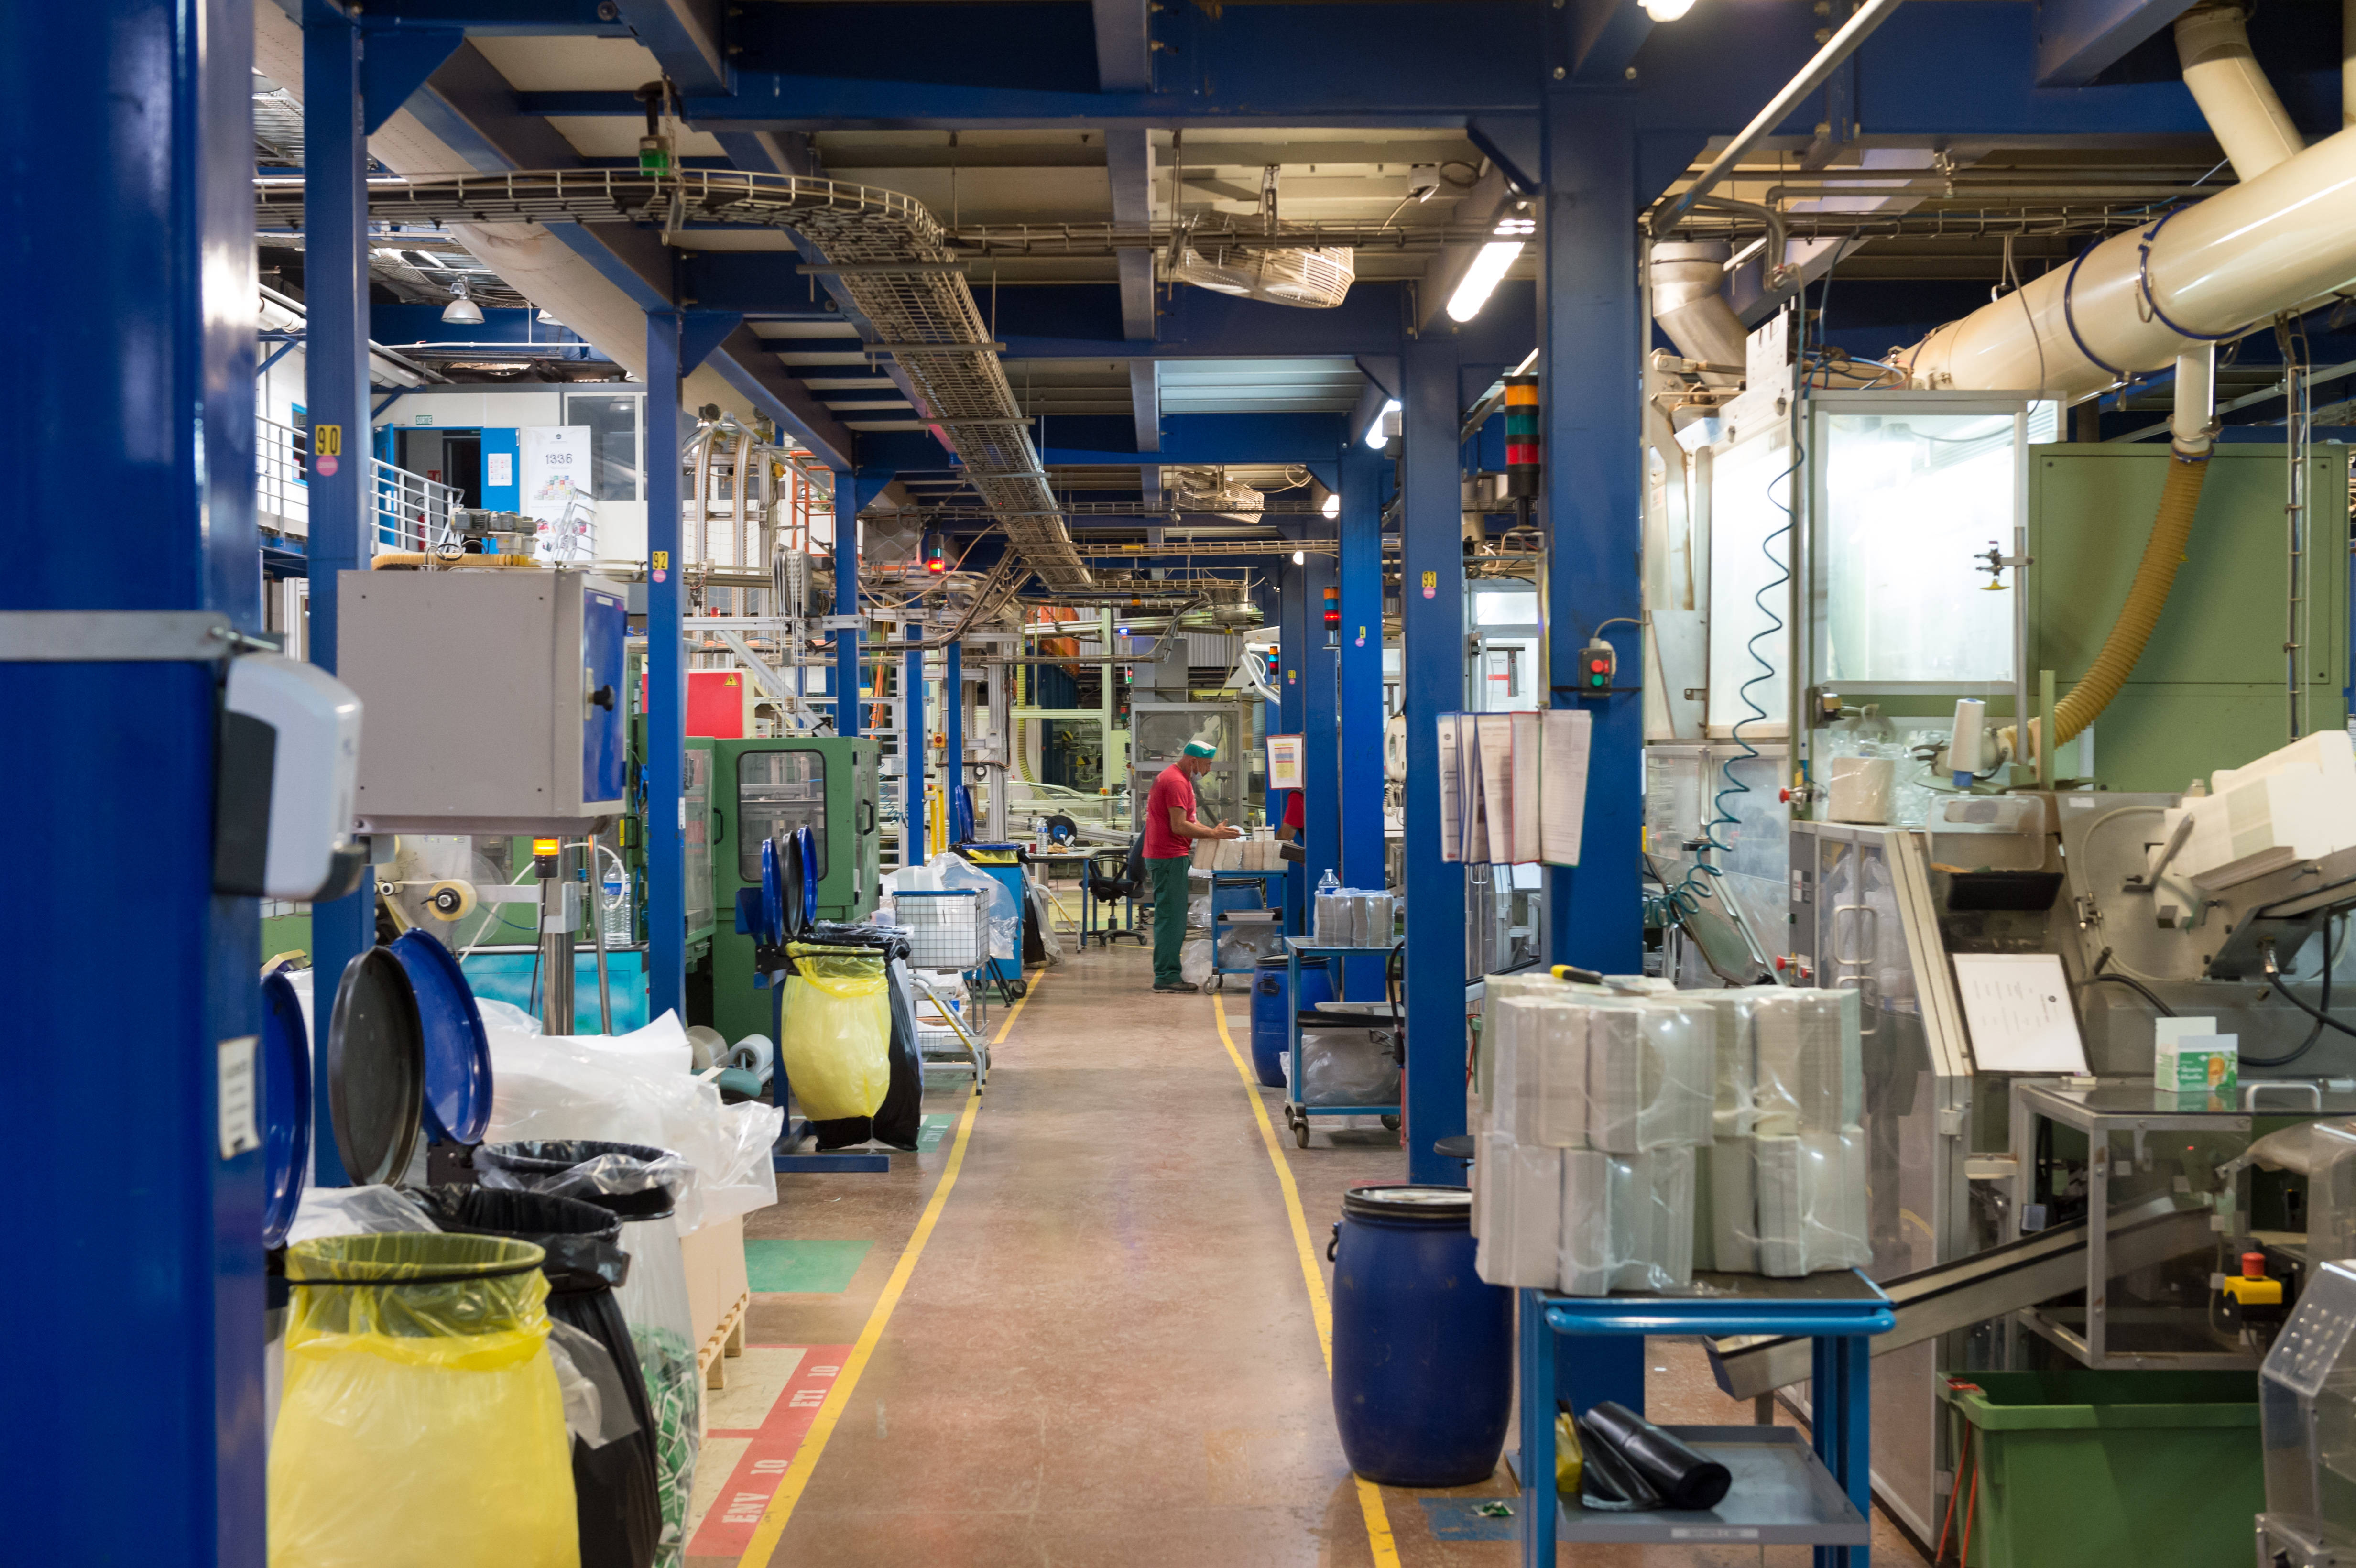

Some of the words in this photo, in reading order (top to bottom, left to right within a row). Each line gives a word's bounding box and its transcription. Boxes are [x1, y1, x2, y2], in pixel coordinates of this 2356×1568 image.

[416, 416, 432, 425] SORTIE
[318, 427, 338, 454] 90
[546, 454, 573, 464] 1336
[654, 553, 666, 569] 92
[1424, 572, 1434, 587] 93
[789, 1389, 827, 1407] ETI
[808, 1365, 840, 1377] 10
[722, 1492, 771, 1524] ENV
[751, 1459, 789, 1474] 10
